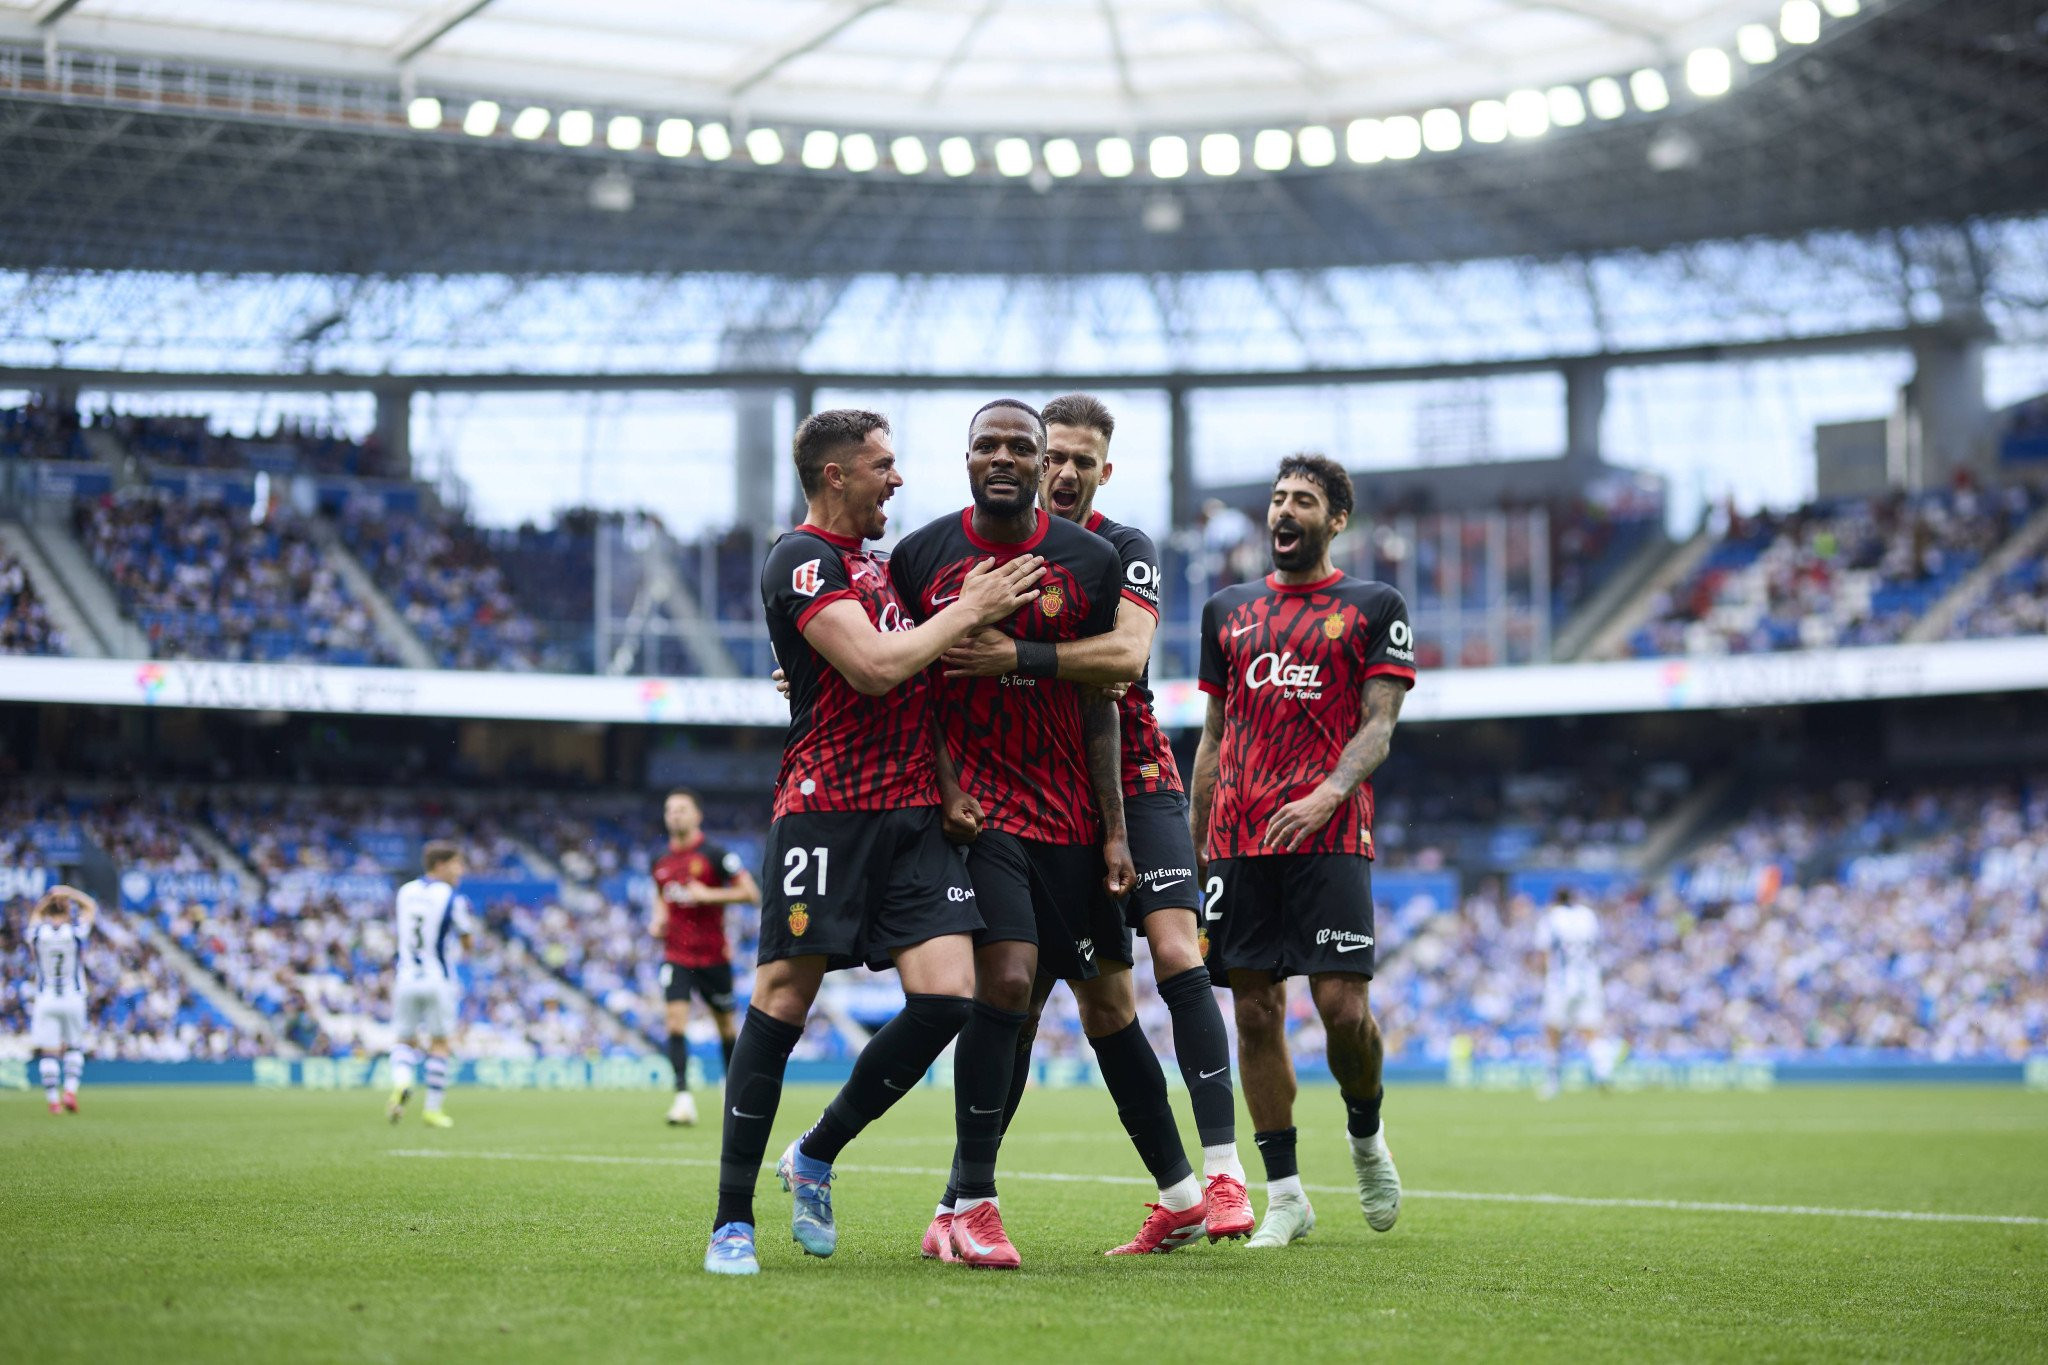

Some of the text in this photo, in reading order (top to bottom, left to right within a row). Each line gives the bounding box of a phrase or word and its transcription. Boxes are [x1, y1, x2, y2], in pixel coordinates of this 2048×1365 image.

[1283, 687, 1322, 701] by Taica
[783, 846, 829, 897] 21
[1144, 868, 1192, 883] AirEuropa
[1205, 875, 1224, 921] 2
